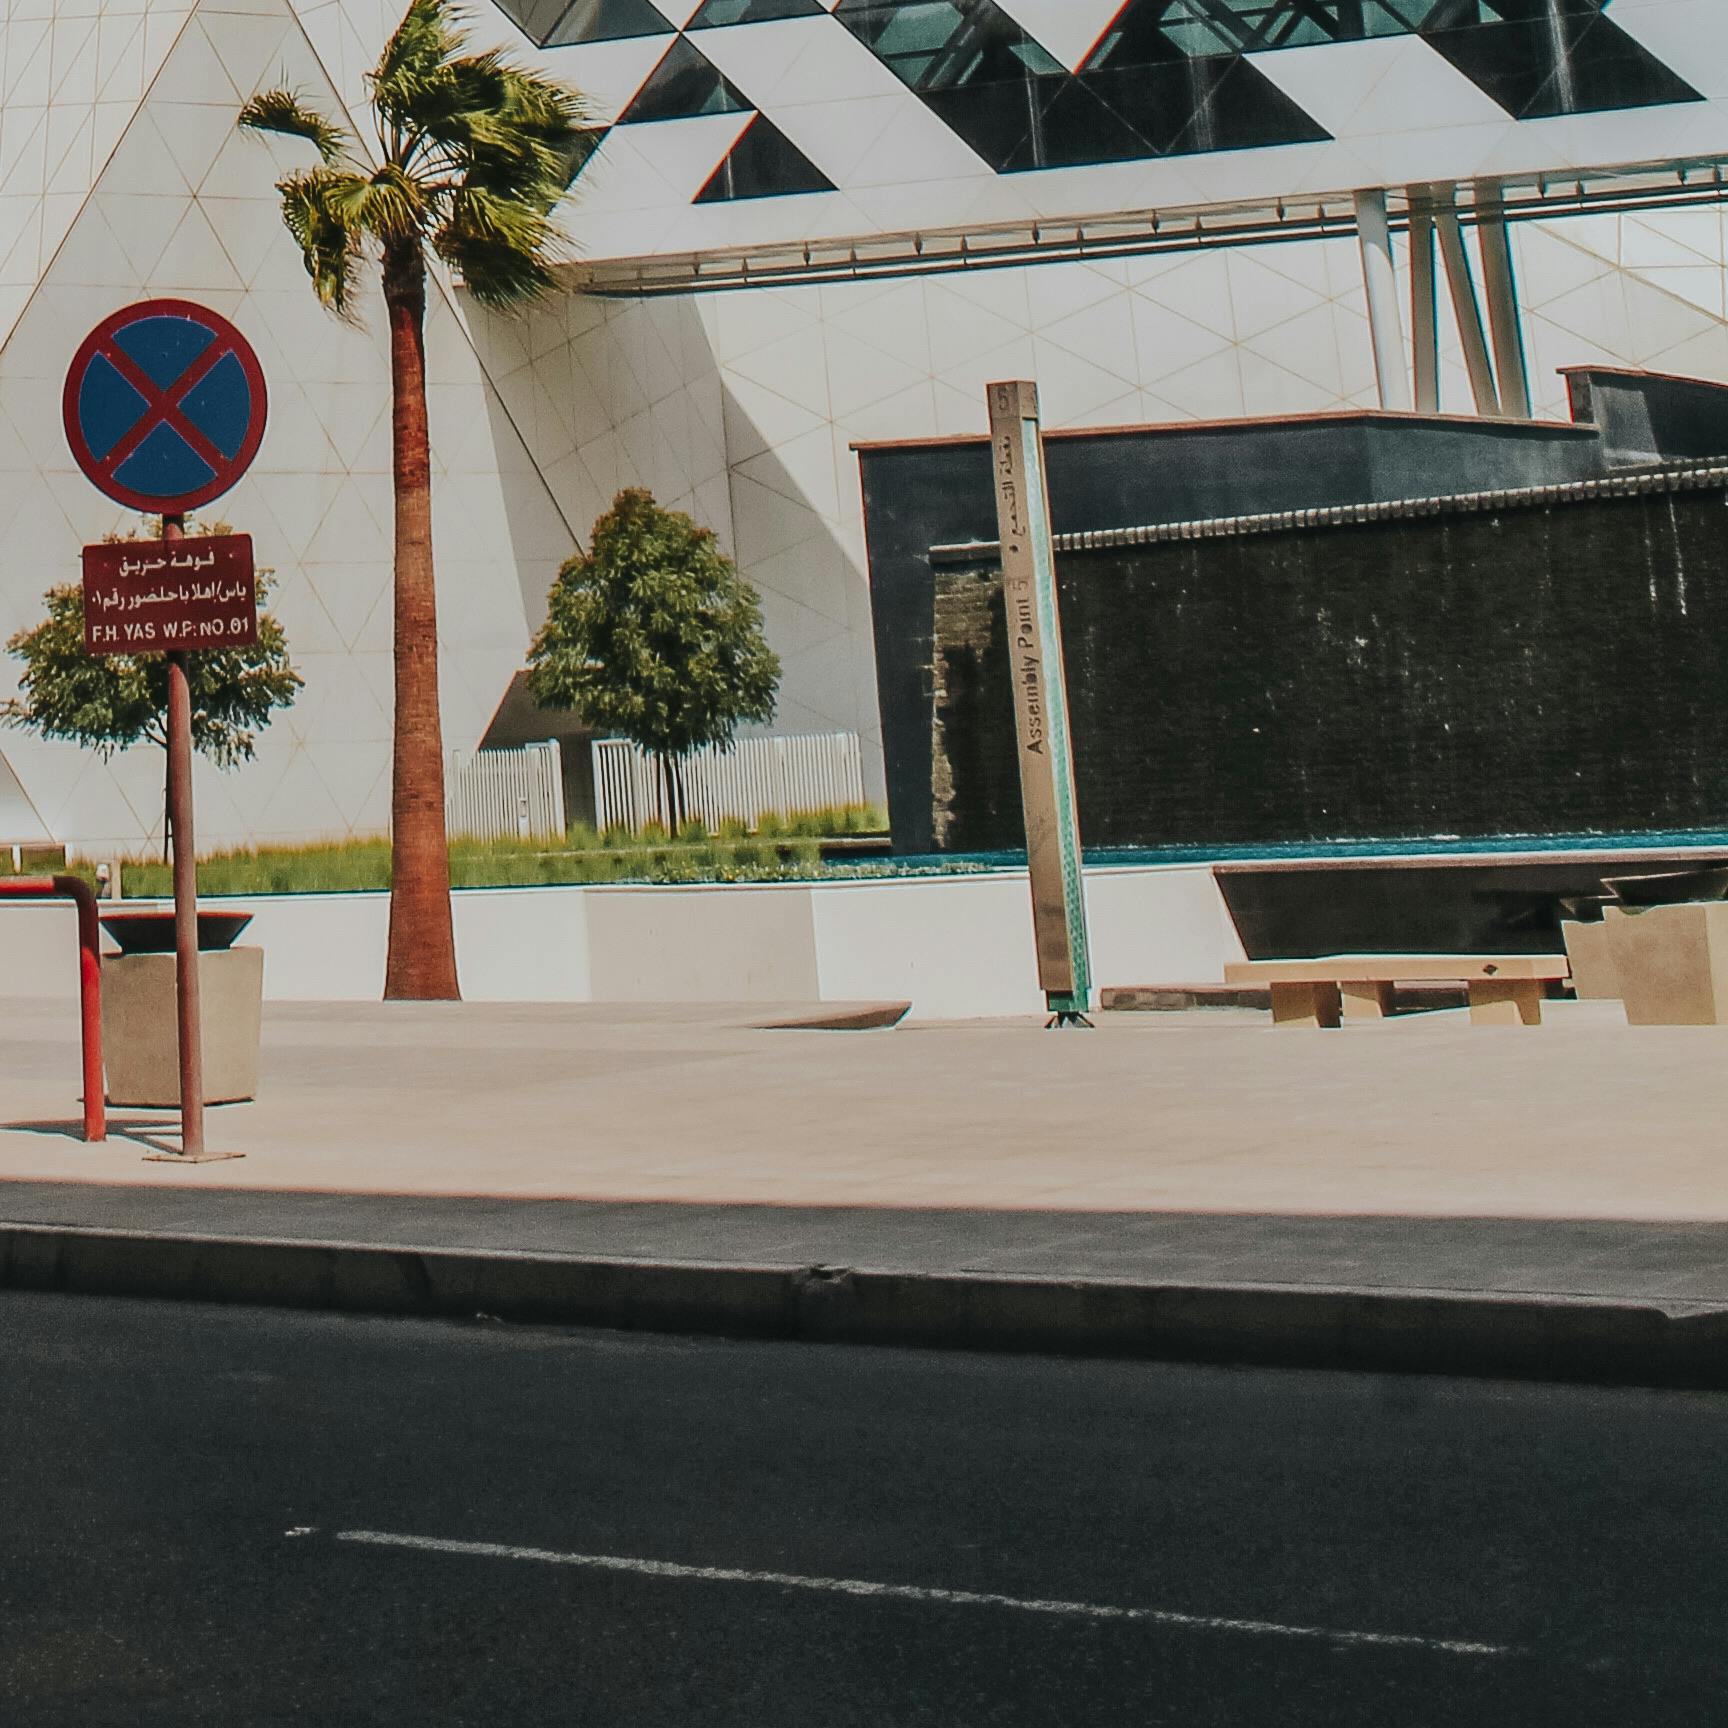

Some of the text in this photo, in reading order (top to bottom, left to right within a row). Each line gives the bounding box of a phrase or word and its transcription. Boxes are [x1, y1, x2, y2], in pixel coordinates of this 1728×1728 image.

[170, 545, 215, 570] فوهة
[103, 587, 125, 612] رقم
[124, 622, 156, 640] YAS
[1016, 597, 1034, 650] Point
[1021, 656, 1043, 755] Assembly
